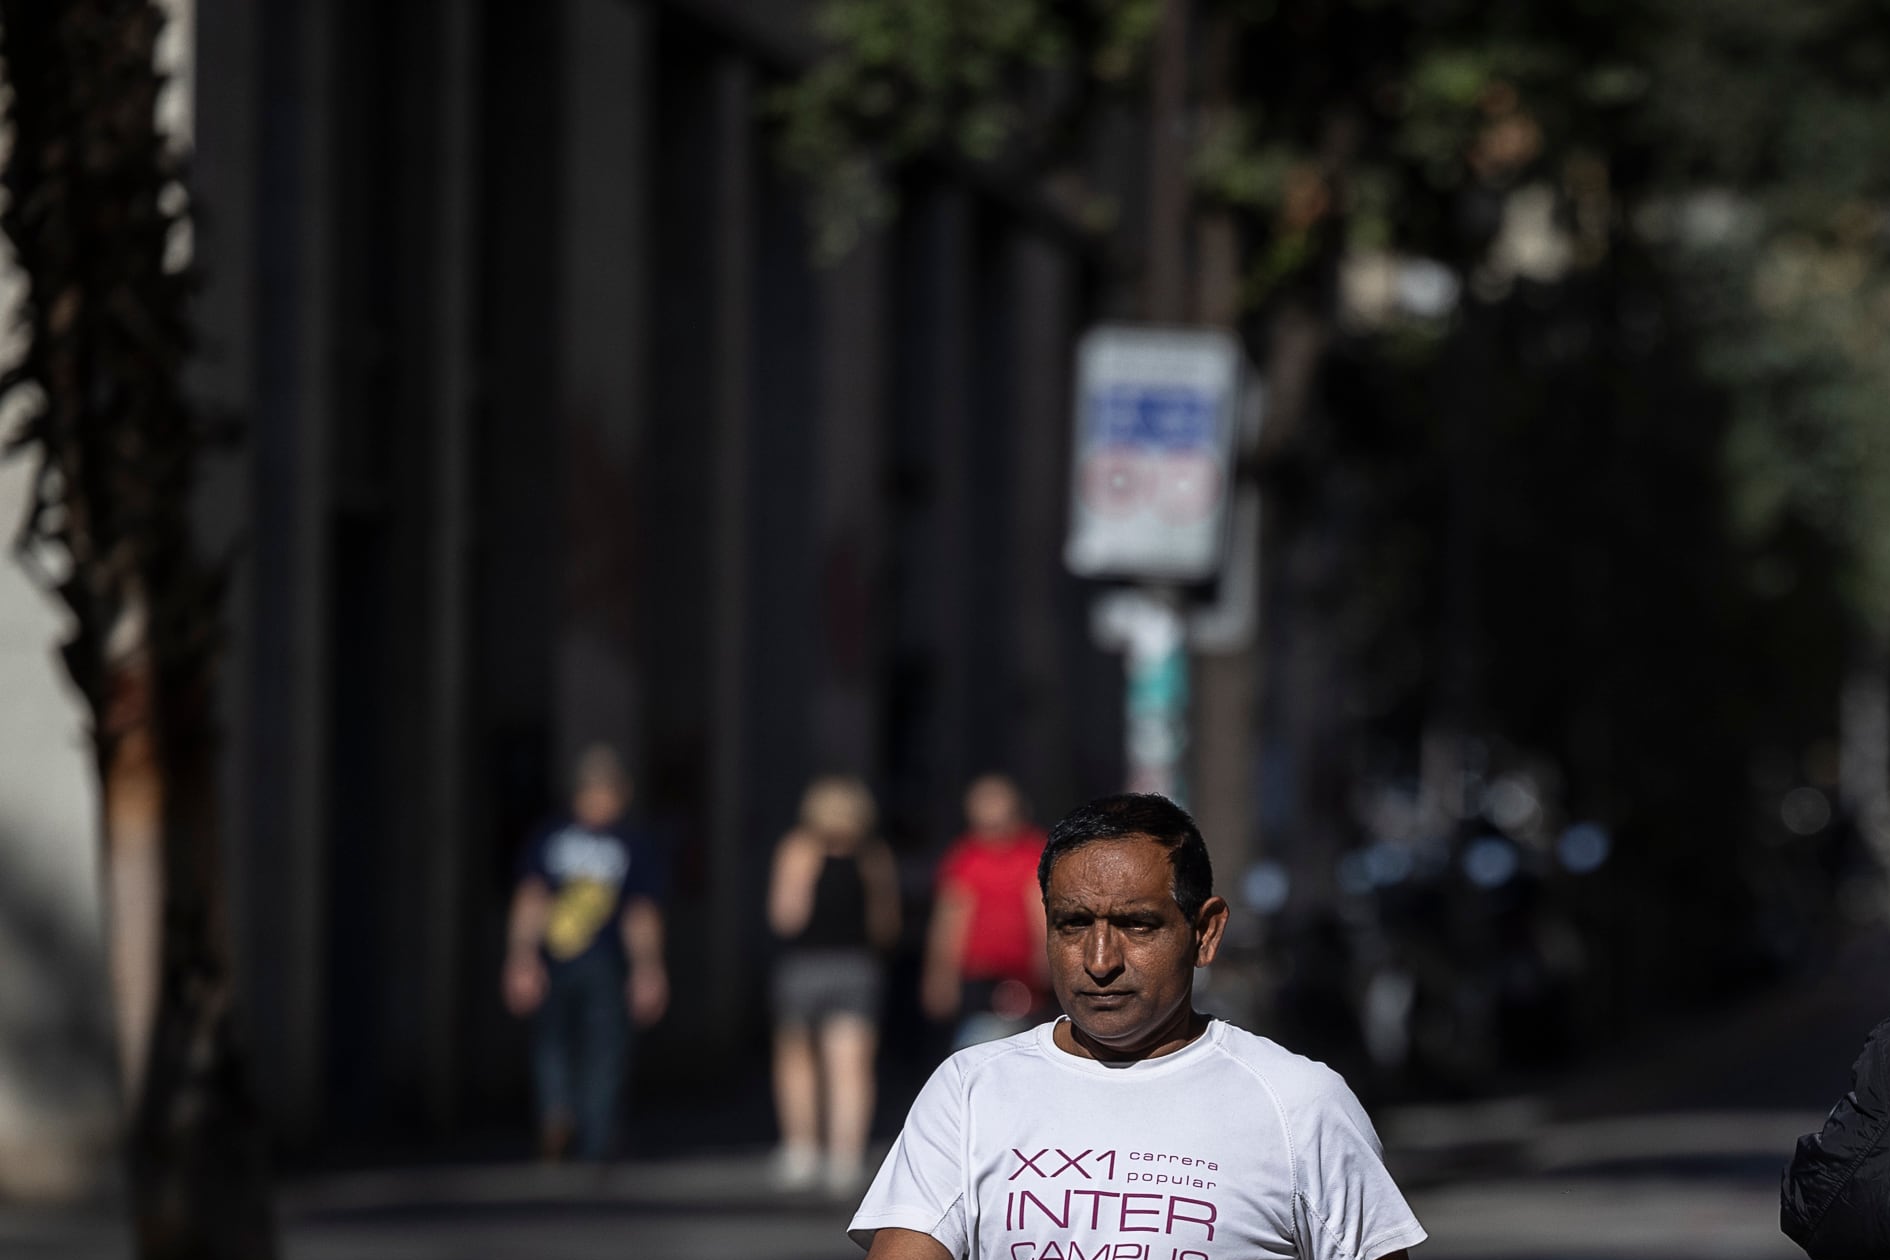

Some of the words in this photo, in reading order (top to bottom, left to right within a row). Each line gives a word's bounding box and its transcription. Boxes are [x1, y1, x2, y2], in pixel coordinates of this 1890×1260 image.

[1129, 1151, 1219, 1172] carrera
[1127, 1172, 1217, 1191] popular
[1006, 1189, 1217, 1242] INTER
